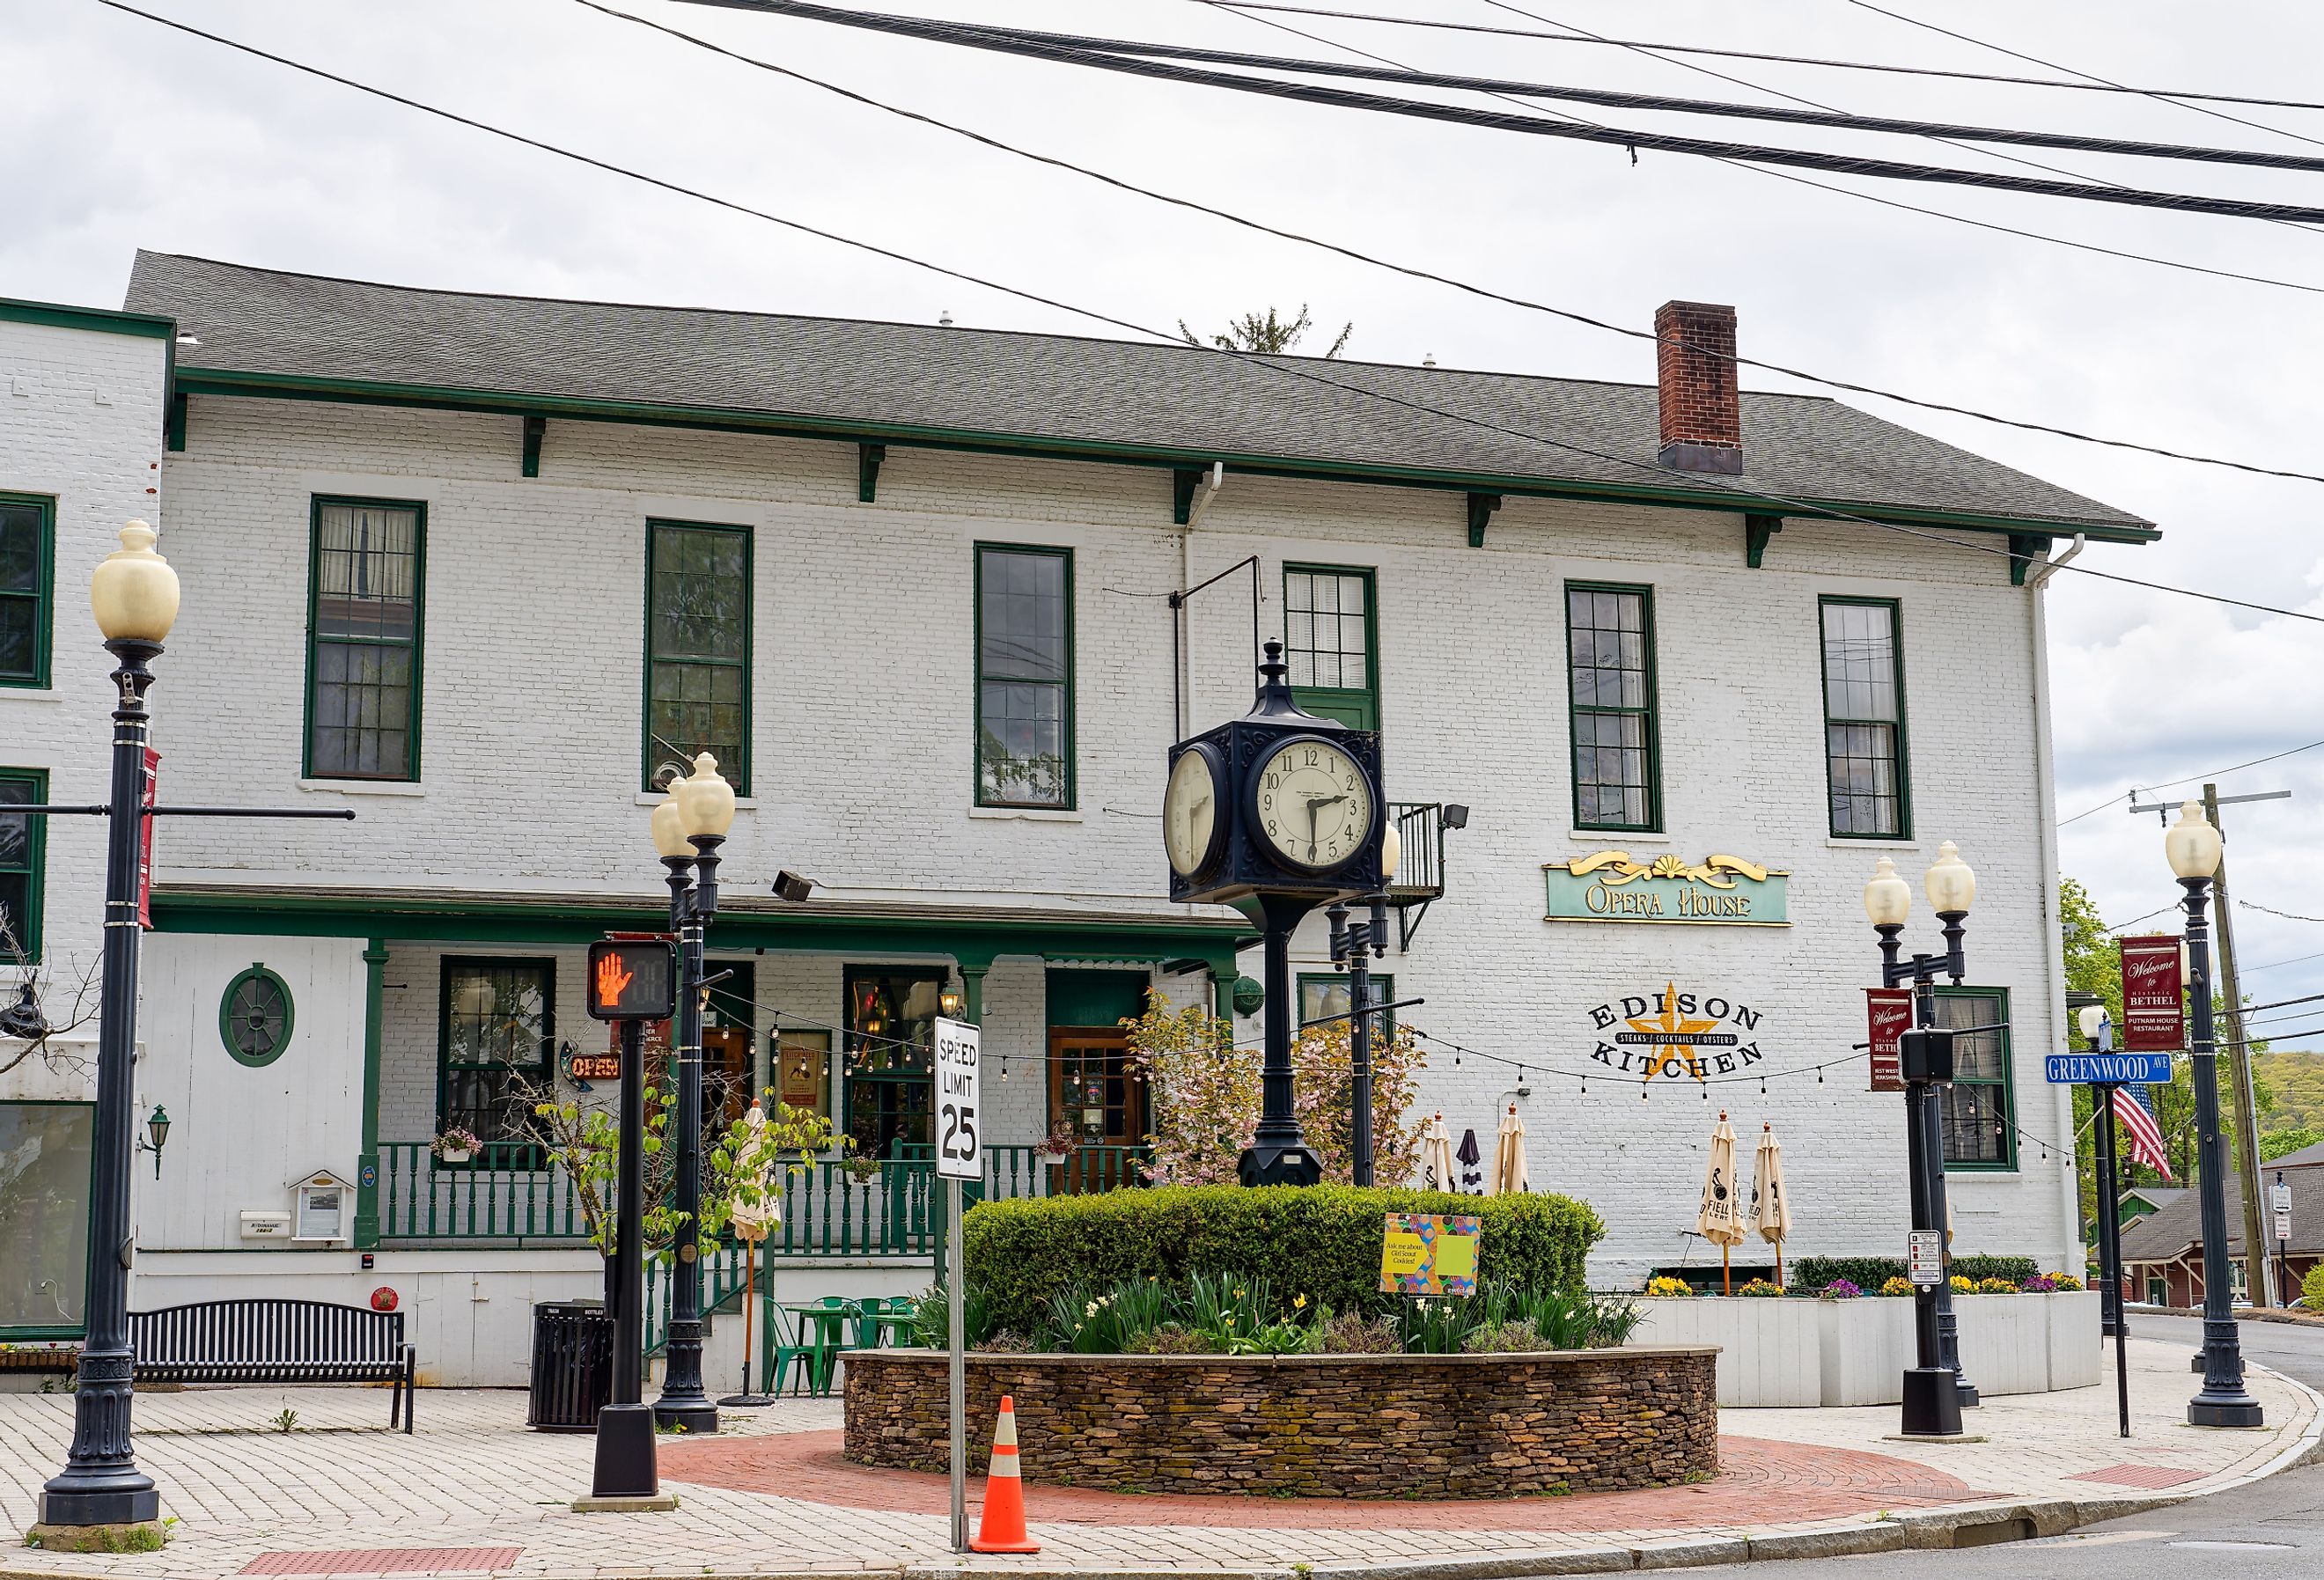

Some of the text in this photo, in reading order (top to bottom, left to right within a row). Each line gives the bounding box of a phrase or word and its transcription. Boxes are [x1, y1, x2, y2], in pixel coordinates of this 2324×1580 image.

[1282, 755, 1293, 772] 11
[1305, 749, 1319, 767] 12
[1329, 757, 1335, 774] 1
[1266, 773, 1279, 790] 10
[1346, 775, 1355, 791] 2
[1264, 794, 1272, 811] 9
[1350, 799, 1357, 816] 3
[1268, 819, 1277, 837] 8
[1344, 824, 1354, 841] 4
[1285, 839, 1297, 856] 7
[1328, 840, 1337, 857] 5
[2128, 955, 2175, 979] Welcome
[2147, 977, 2157, 987] to
[2130, 996, 2177, 1006] BETHEL
[1588, 993, 1763, 1031] EDISON
[1873, 1006, 1908, 1026] Welcome
[1620, 1033, 1647, 1043] STEAKS
[1656, 1034, 1694, 1044] COCKTAILS
[1703, 1035, 1733, 1045] OYSTERS
[1886, 1026, 1894, 1035] to
[939, 1039, 976, 1067] SPEED
[1874, 1043, 1898, 1052] BETH
[572, 1057, 620, 1077] OPEN
[1590, 1040, 1764, 1078] KITCHEN
[2048, 1056, 2168, 1080] GREENWOOD AVE
[944, 1070, 973, 1098] LIMIT
[942, 1103, 976, 1162] 25
[1406, 1242, 1423, 1251] about
